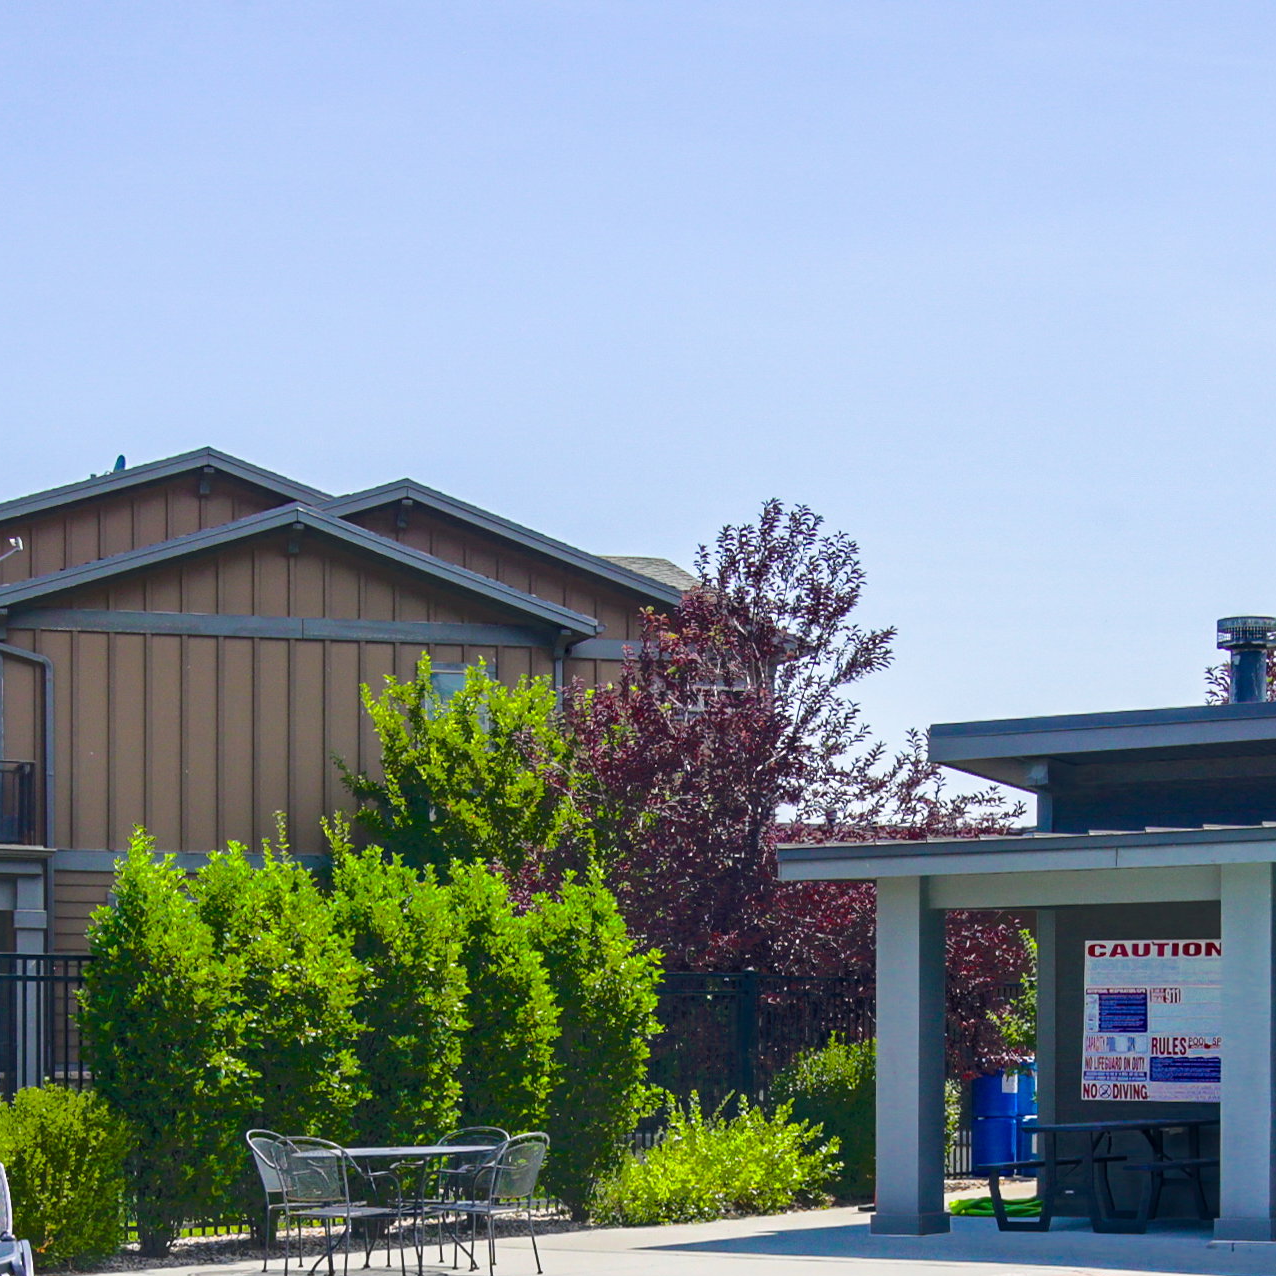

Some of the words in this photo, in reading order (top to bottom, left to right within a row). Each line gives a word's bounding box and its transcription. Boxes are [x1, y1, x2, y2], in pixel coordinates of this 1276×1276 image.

[1087, 942, 1221, 958] CAUTION
[1165, 987, 1181, 1004] 911
[1151, 1036, 1187, 1056] RULES
[1084, 1055, 1092, 1070] NO
[1093, 1055, 1122, 1070] LIFEGUARD
[1124, 1055, 1131, 1070] ON
[1132, 1055, 1145, 1070] DUTY
[1083, 1082, 1098, 1099] NO
[1112, 1083, 1149, 1100] DIVING
